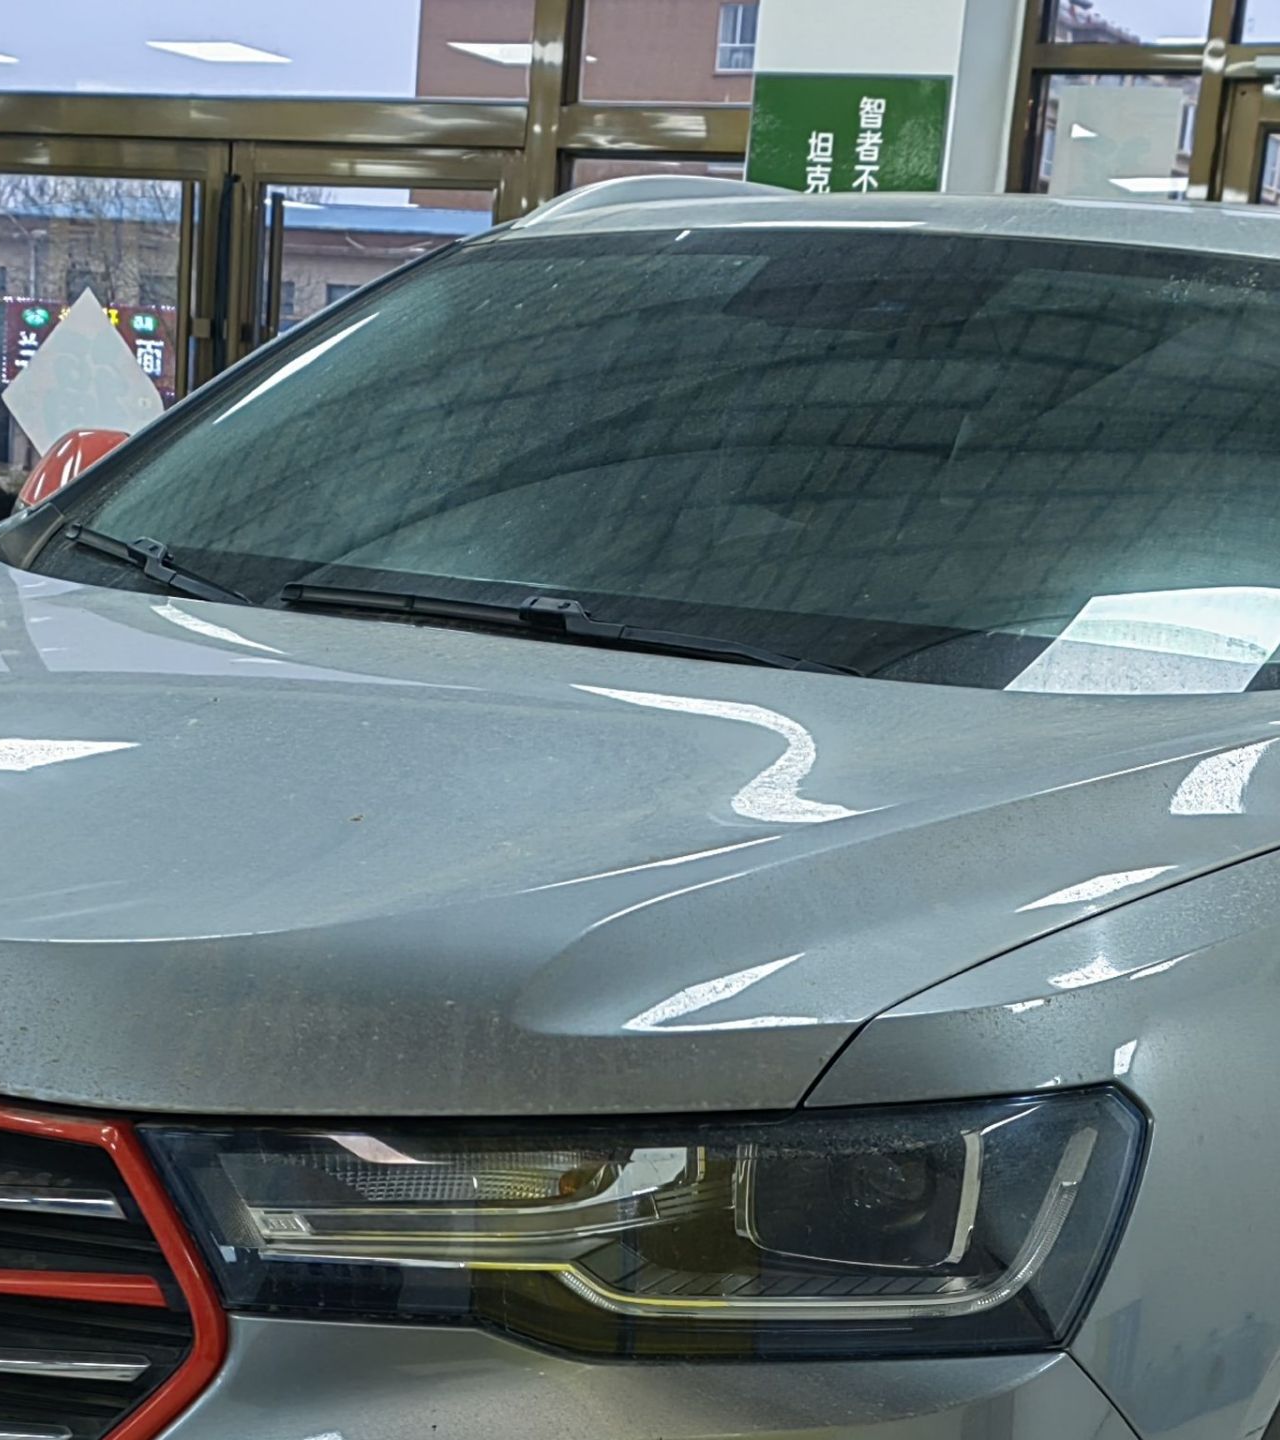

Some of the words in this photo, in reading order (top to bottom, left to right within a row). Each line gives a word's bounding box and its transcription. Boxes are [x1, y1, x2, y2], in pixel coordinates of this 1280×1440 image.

[804, 130, 835, 194] 坦克
[851, 95, 887, 193] 智者不
